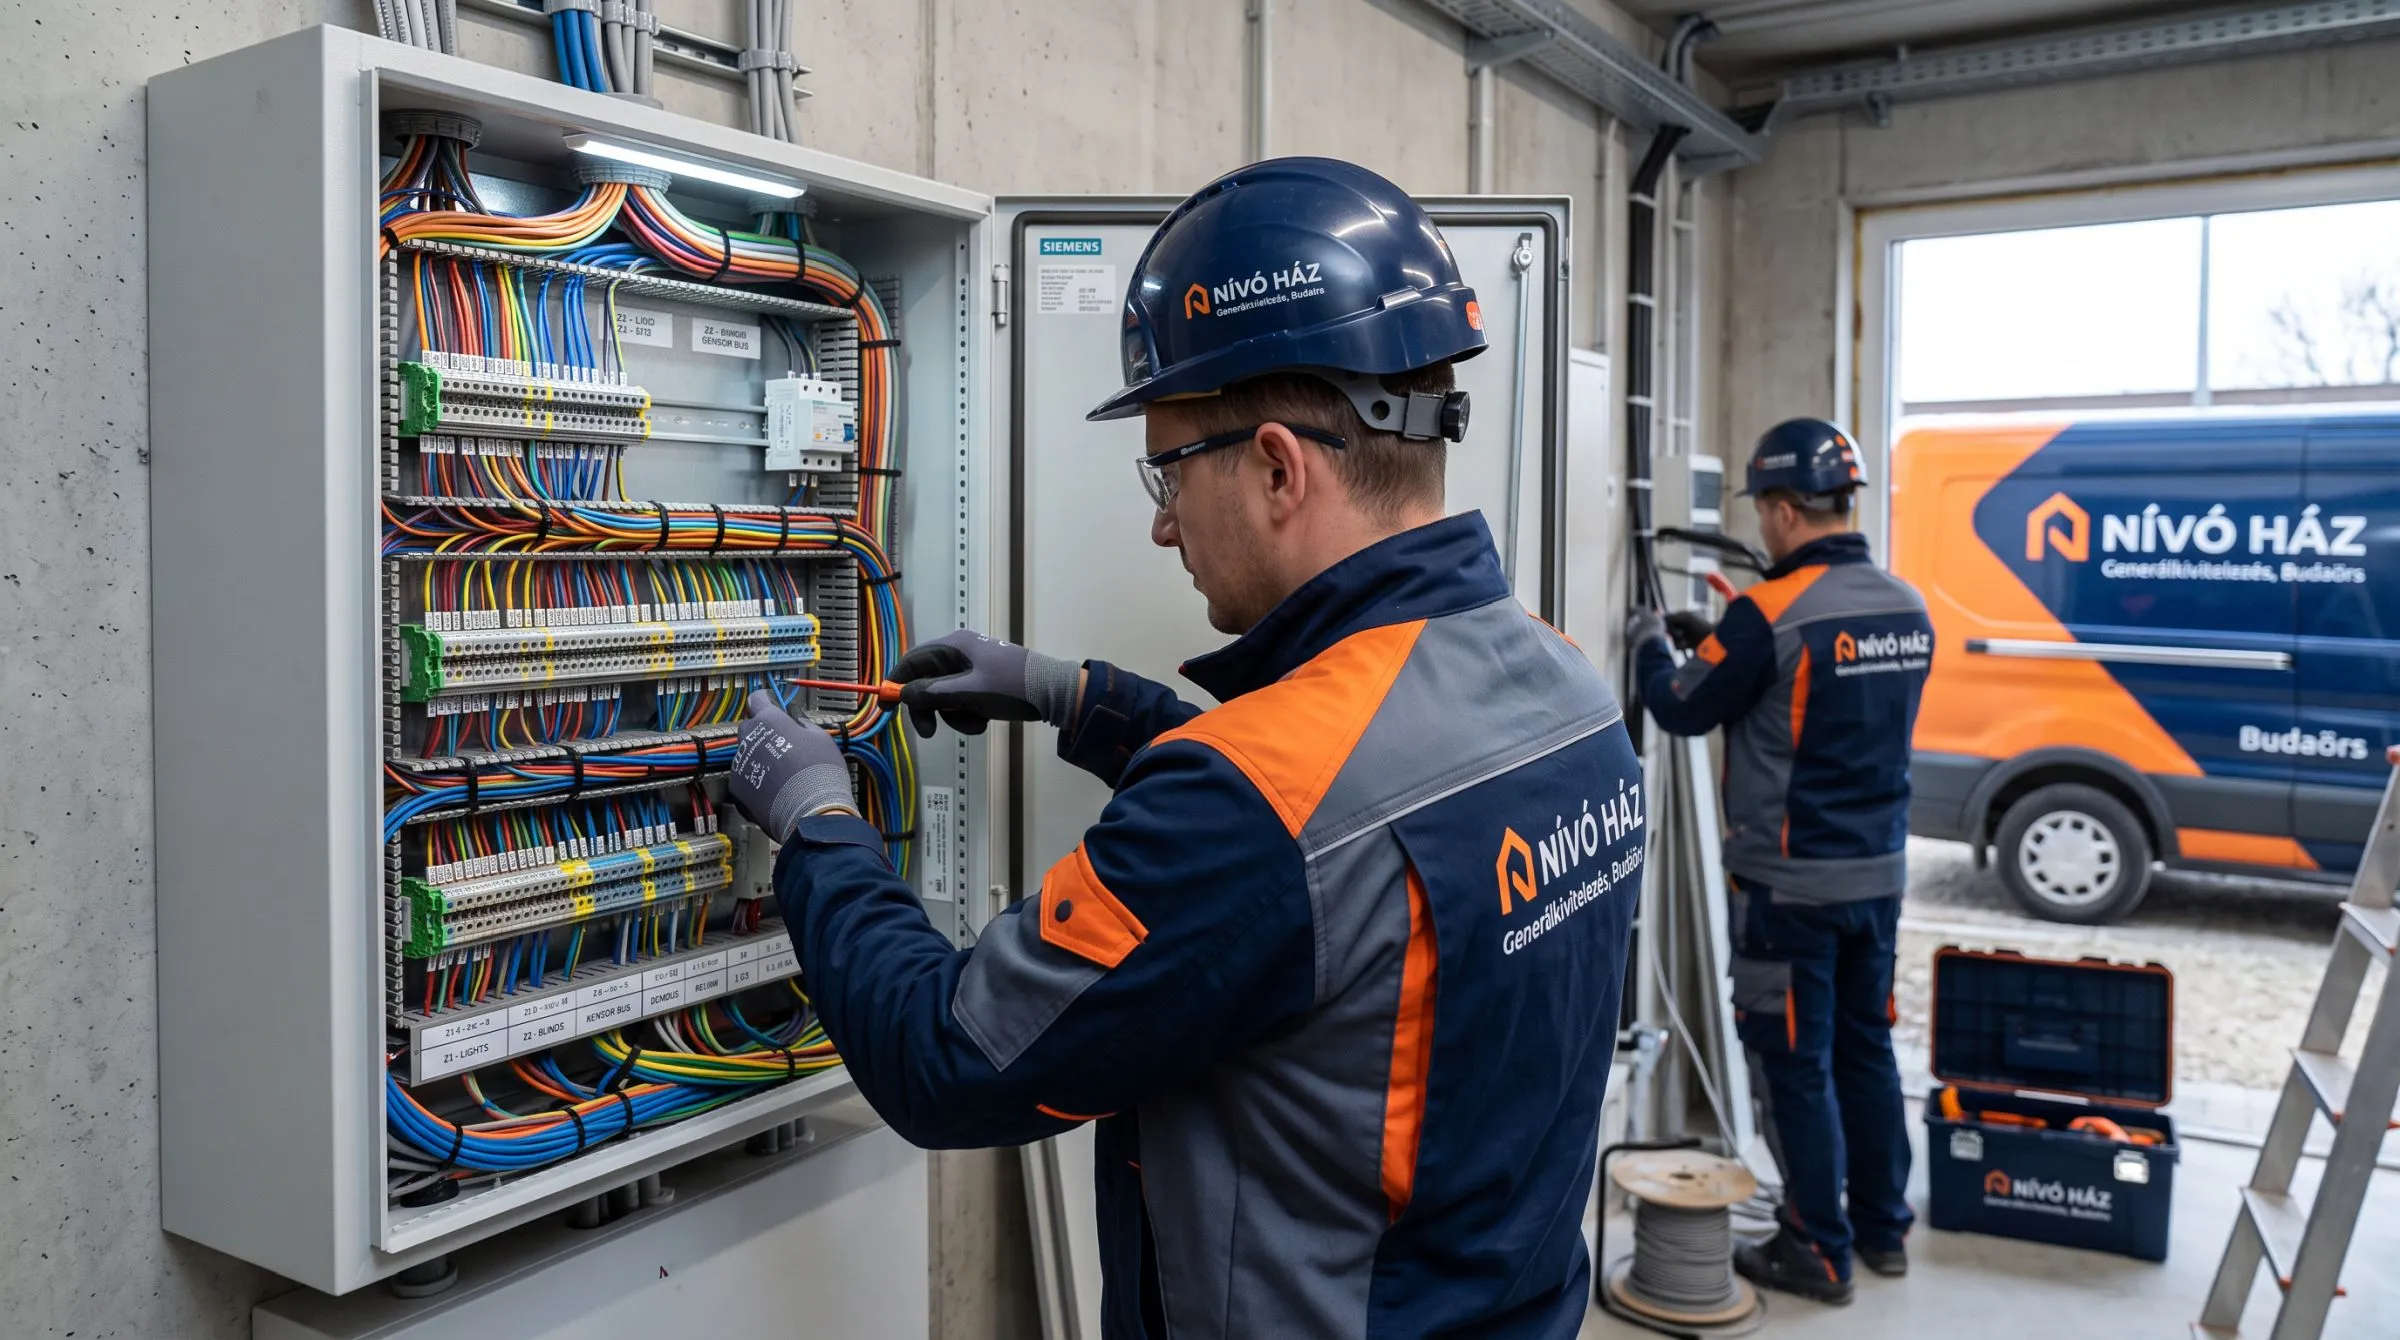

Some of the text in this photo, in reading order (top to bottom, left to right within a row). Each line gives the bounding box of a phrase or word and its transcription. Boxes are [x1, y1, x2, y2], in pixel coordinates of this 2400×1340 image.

[1043, 241, 1099, 252] SIEMENS
[1213, 260, 1322, 304] NÍVÓ HÁZ
[2102, 503, 2367, 557] NÍVÓ HÁZ
[1858, 630, 1930, 658] NÍVÓ HÁZ
[1538, 778, 1643, 886] NÍVÓ HÁZ
[1503, 870, 1611, 955] Generálkivitelezés,
[617, 1004, 631, 1015] BUS
[538, 1022, 565, 1037] BLINDS
[460, 1043, 489, 1059] LIGHTS
